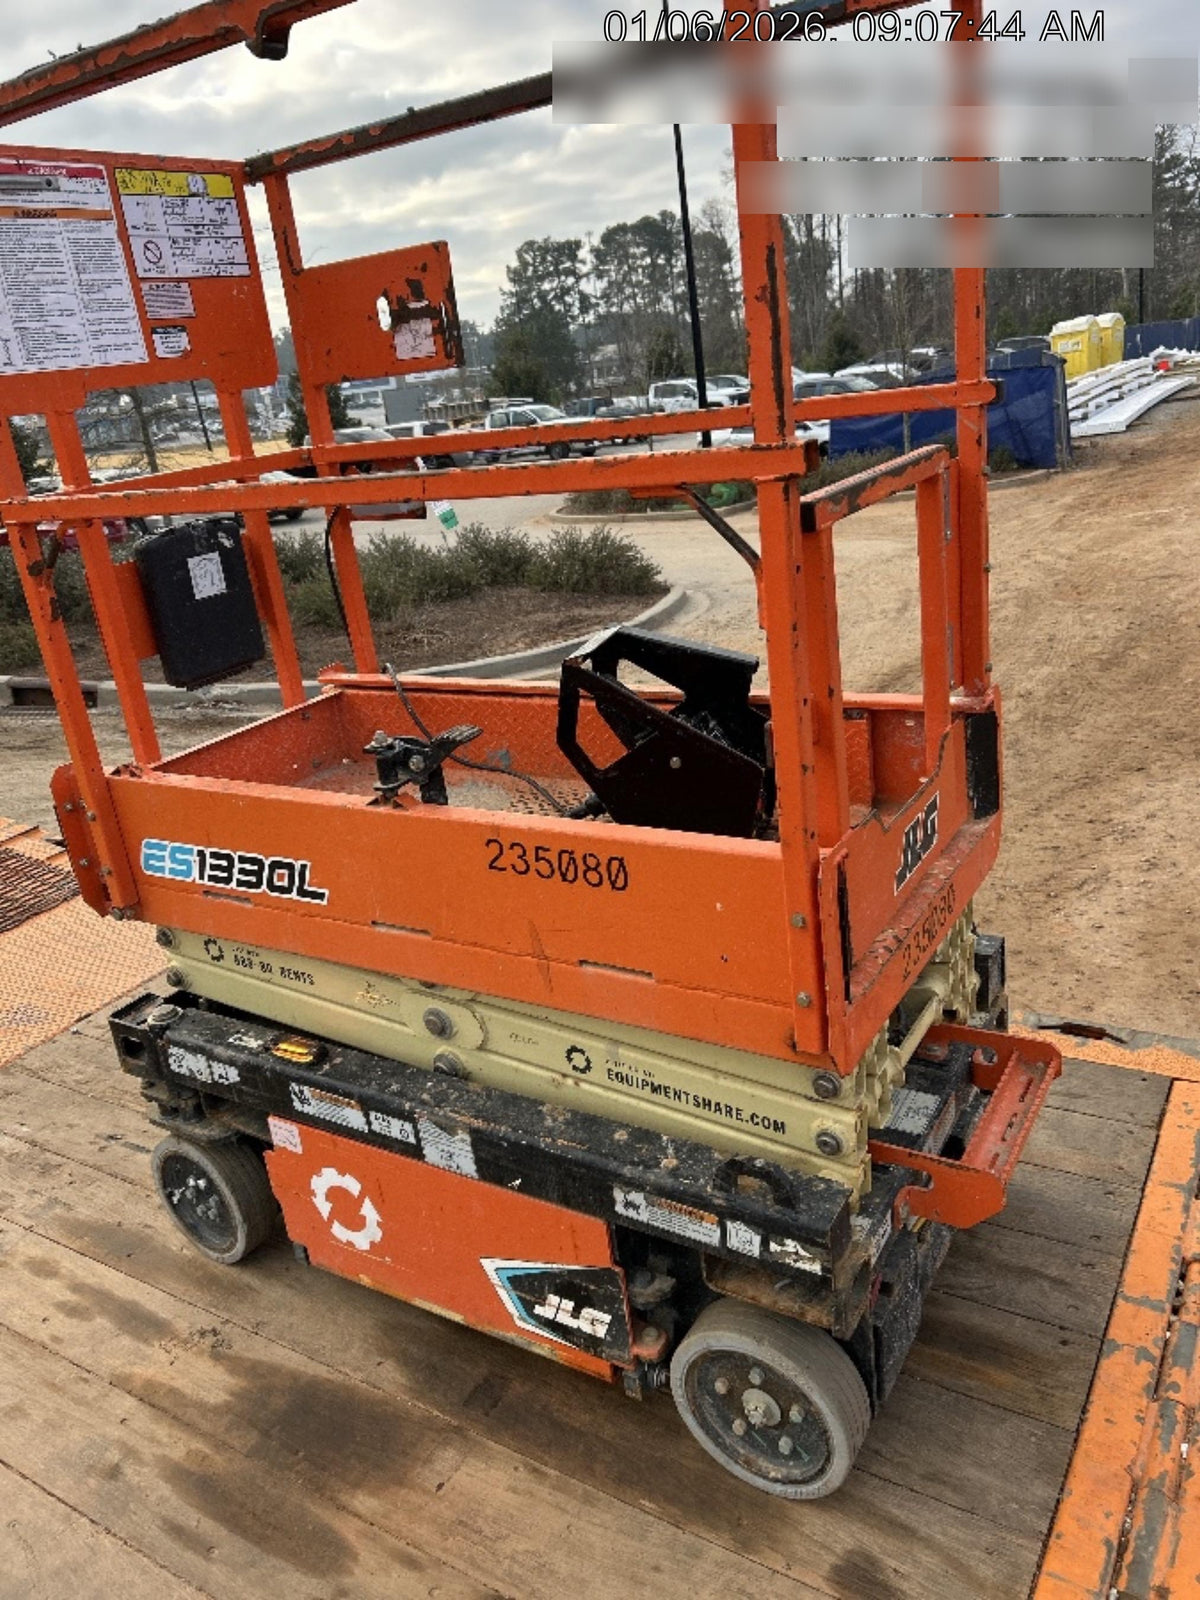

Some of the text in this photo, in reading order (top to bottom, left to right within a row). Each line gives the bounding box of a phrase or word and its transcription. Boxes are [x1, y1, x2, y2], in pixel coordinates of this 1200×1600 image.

[141, 838, 329, 906] ES1330L
[484, 837, 629, 892] 235080
[894, 791, 940, 897] JLG
[278, 966, 315, 986] RENTS
[606, 1066, 787, 1136] EQUIPMENTSHARE.COM
[532, 1293, 612, 1340] JLG
